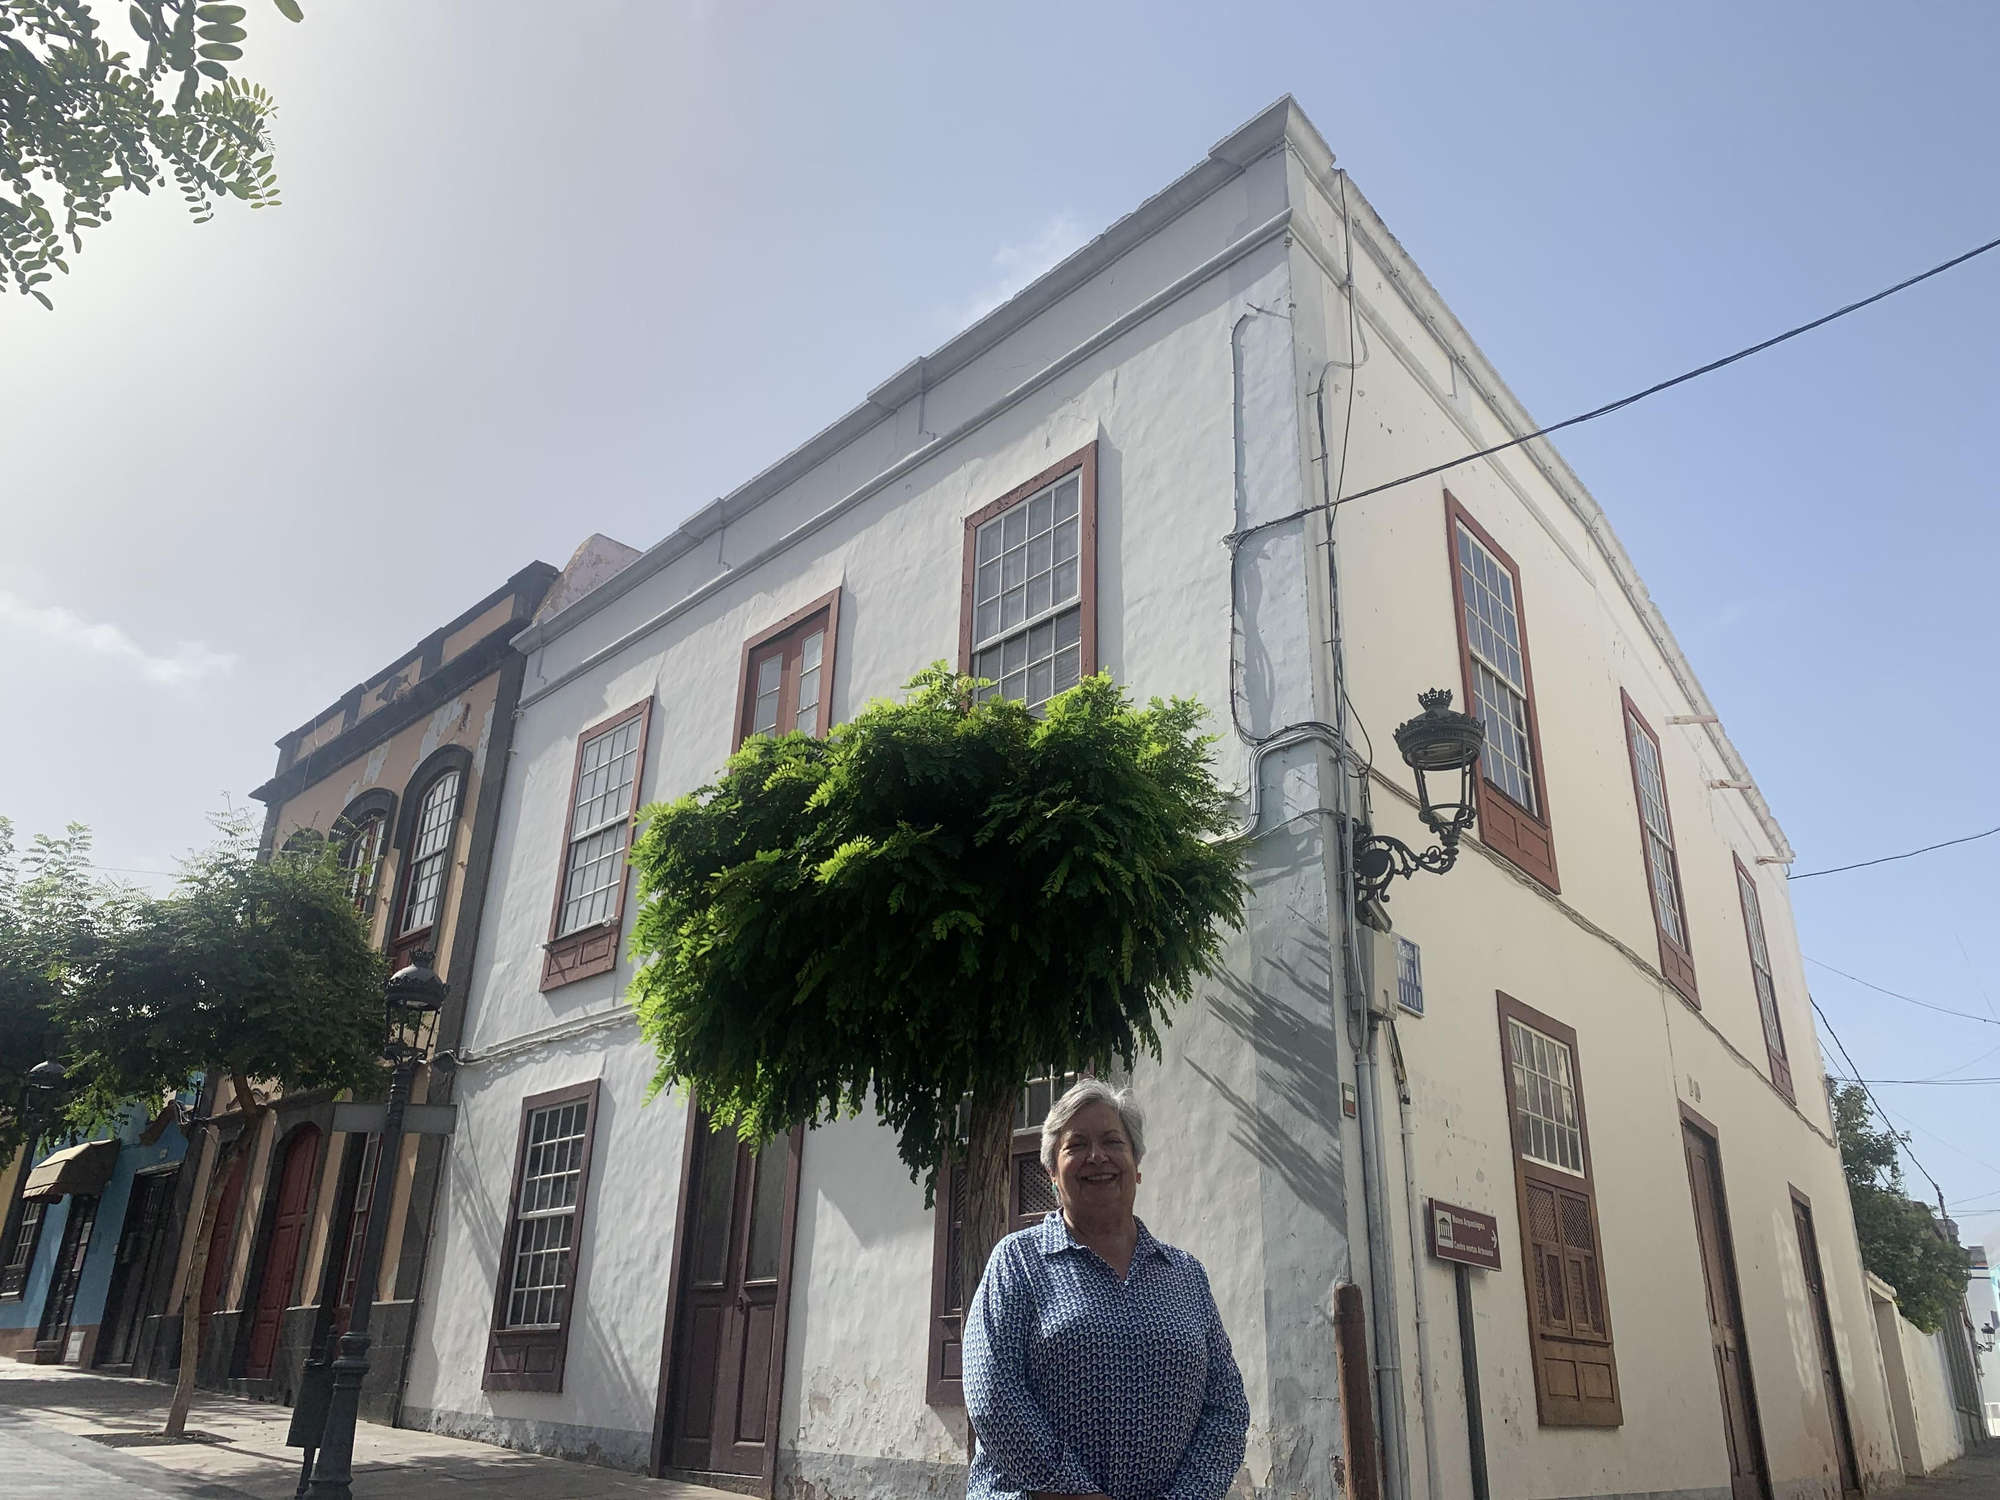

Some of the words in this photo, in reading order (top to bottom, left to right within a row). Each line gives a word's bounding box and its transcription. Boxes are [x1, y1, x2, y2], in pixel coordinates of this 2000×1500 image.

[1398, 940, 1414, 961] Calle
[1451, 1214, 1463, 1225] Museo
[1454, 1240, 1465, 1251] Centro
